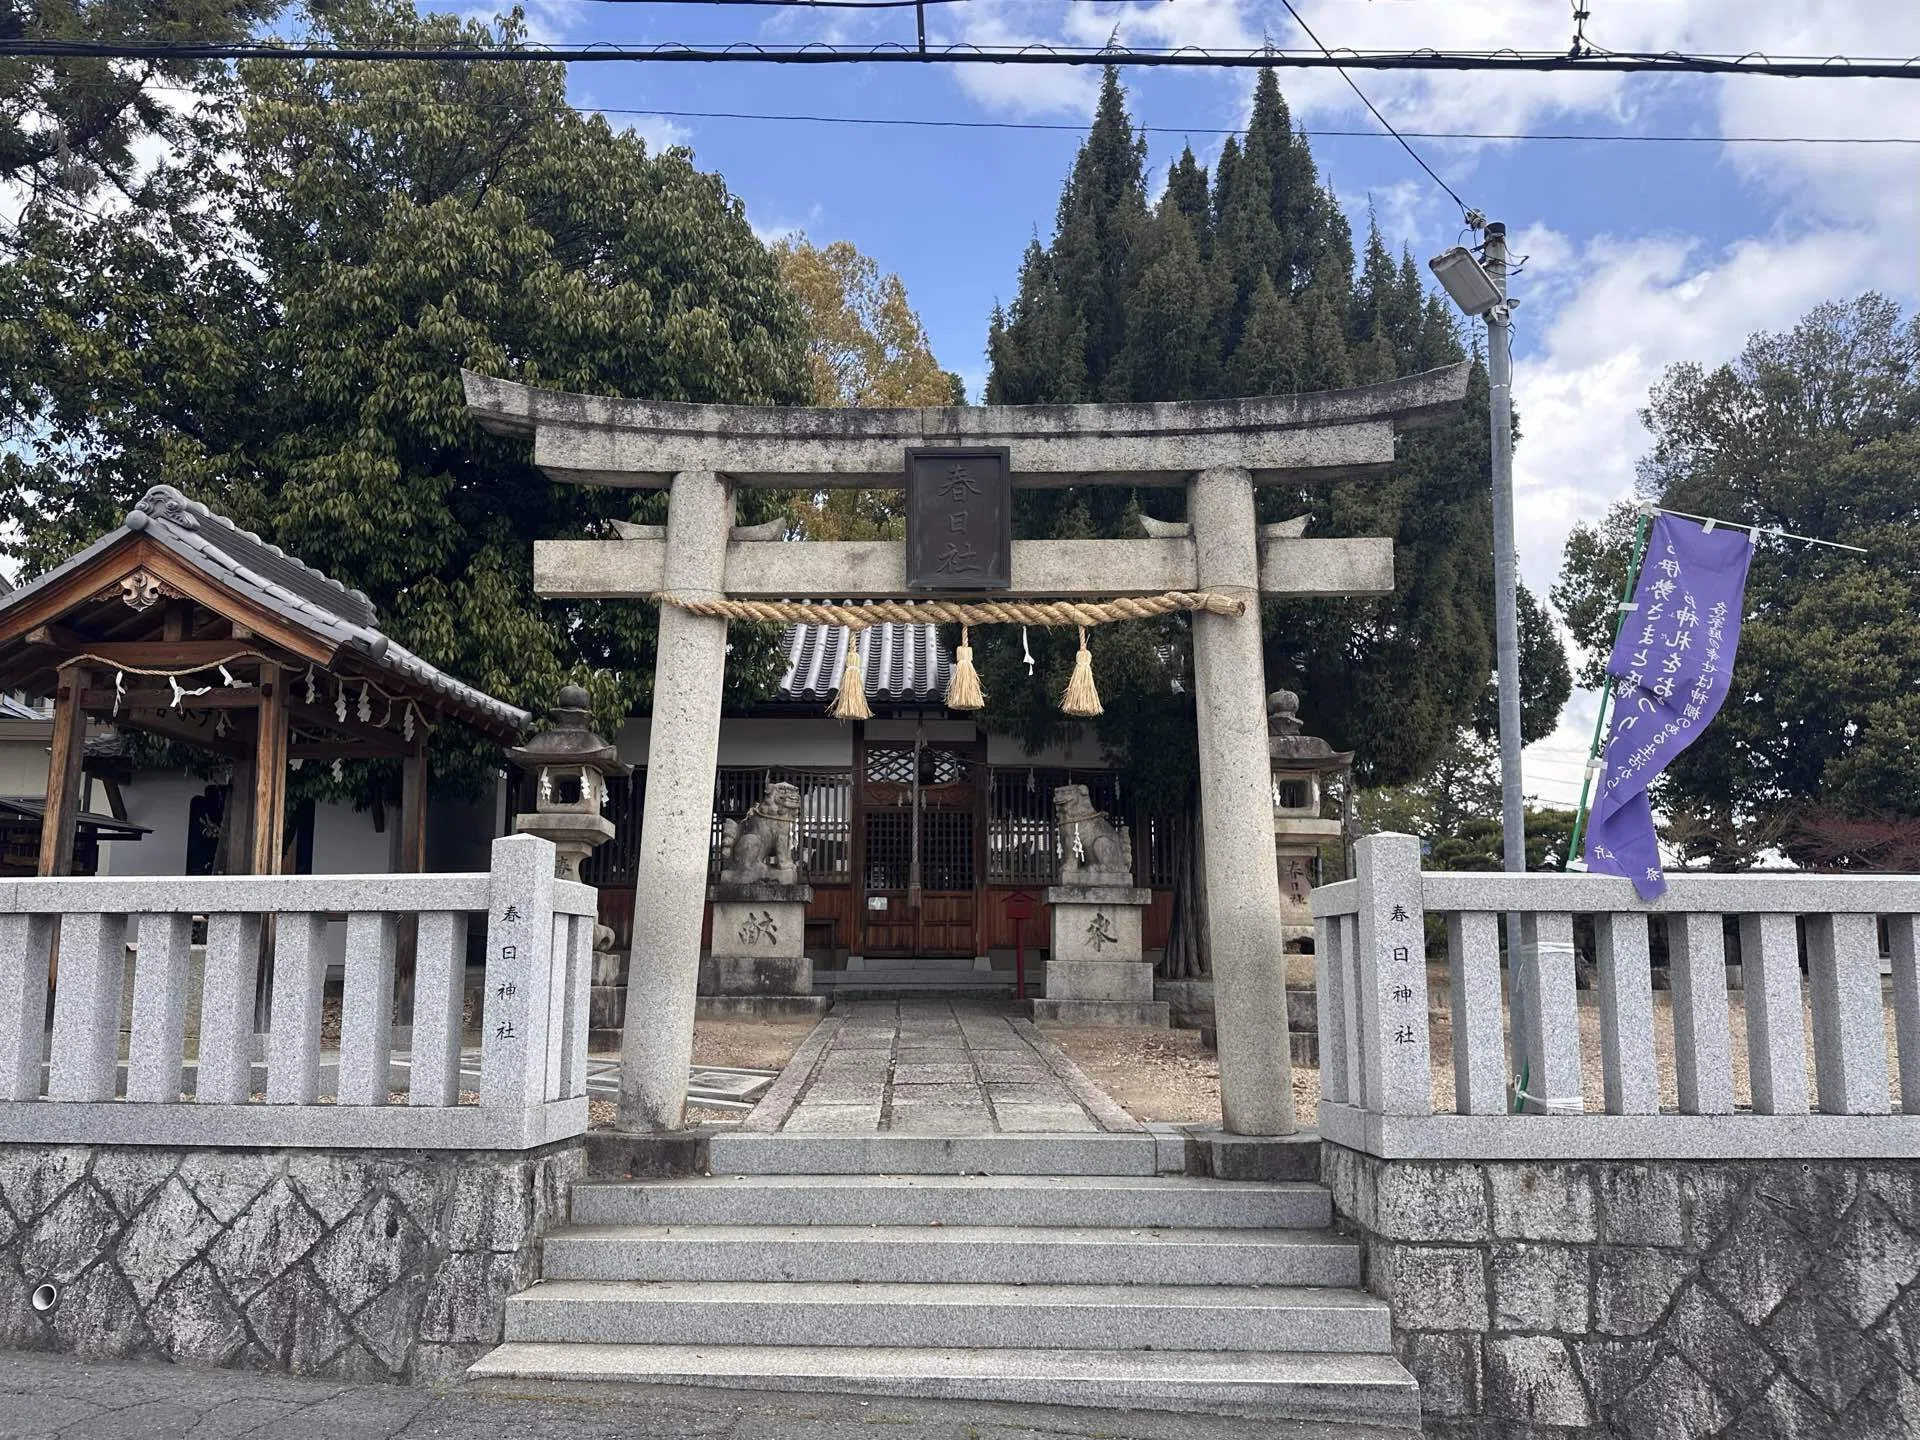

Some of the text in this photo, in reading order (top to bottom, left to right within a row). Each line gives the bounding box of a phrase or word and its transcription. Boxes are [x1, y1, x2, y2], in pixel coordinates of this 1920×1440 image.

[936, 463, 983, 576] 春日社
[496, 905, 521, 1040] 春日神社
[1391, 904, 1416, 1044] 春日神社
